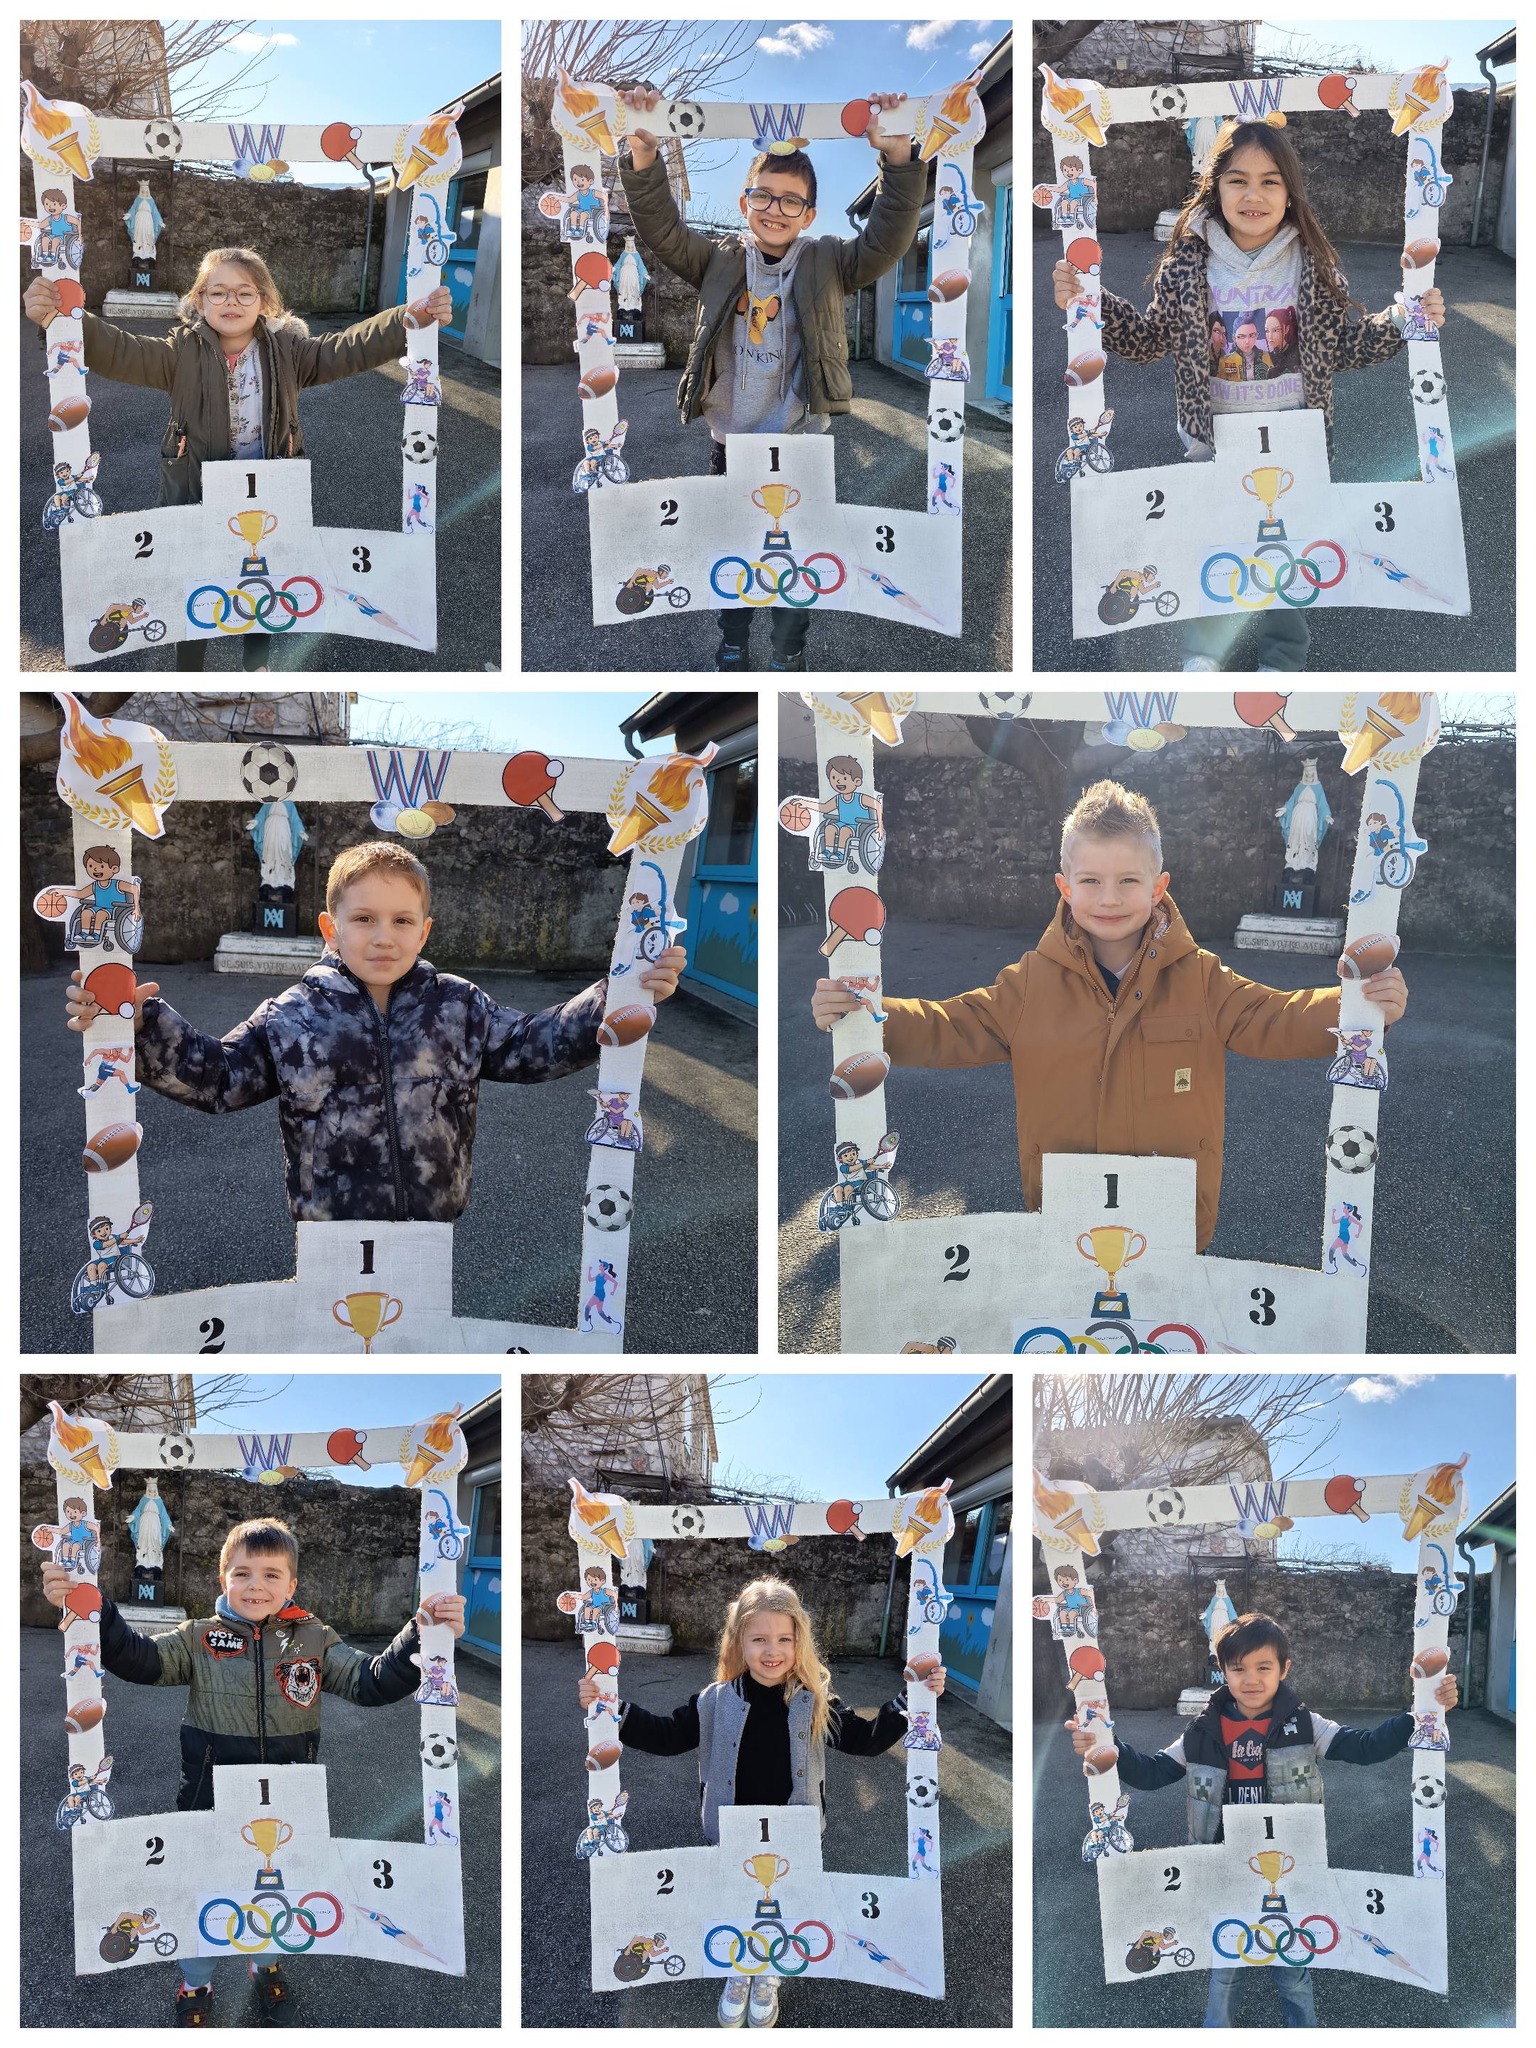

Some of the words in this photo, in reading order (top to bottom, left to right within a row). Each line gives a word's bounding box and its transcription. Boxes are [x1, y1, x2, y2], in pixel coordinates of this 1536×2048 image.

[1210, 381, 1230, 399] OW
[1236, 384, 1264, 400] IT'S
[1267, 377, 1301, 399] DONE
[1257, 427, 1272, 454] 1
[769, 447, 780, 472] 1
[246, 474, 257, 498] 1
[661, 500, 678, 526] 2
[1146, 490, 1165, 520] 2
[1375, 502, 1395, 532] 3
[135, 531, 153, 559] 2
[876, 525, 895, 553] 3
[353, 546, 371, 572] 3
[1104, 1174, 1119, 1209] 1
[360, 1240, 375, 1274] 1
[944, 1245, 970, 1282] 2
[1249, 1288, 1276, 1326] 3
[200, 1318, 225, 1353] 2
[208, 1630, 233, 1639] NOT
[210, 1638, 243, 1650] SAME
[259, 1778, 271, 1805] 1
[1238, 1786, 1266, 1804] DENI
[759, 1818, 770, 1842] 1
[1264, 1816, 1275, 1839] 1
[146, 1837, 164, 1866] 2
[373, 1860, 393, 1889] 3
[657, 1869, 674, 1895] 2
[1164, 1867, 1181, 1891] 2
[862, 1892, 880, 1919] 3
[1367, 1889, 1385, 1914] 3
